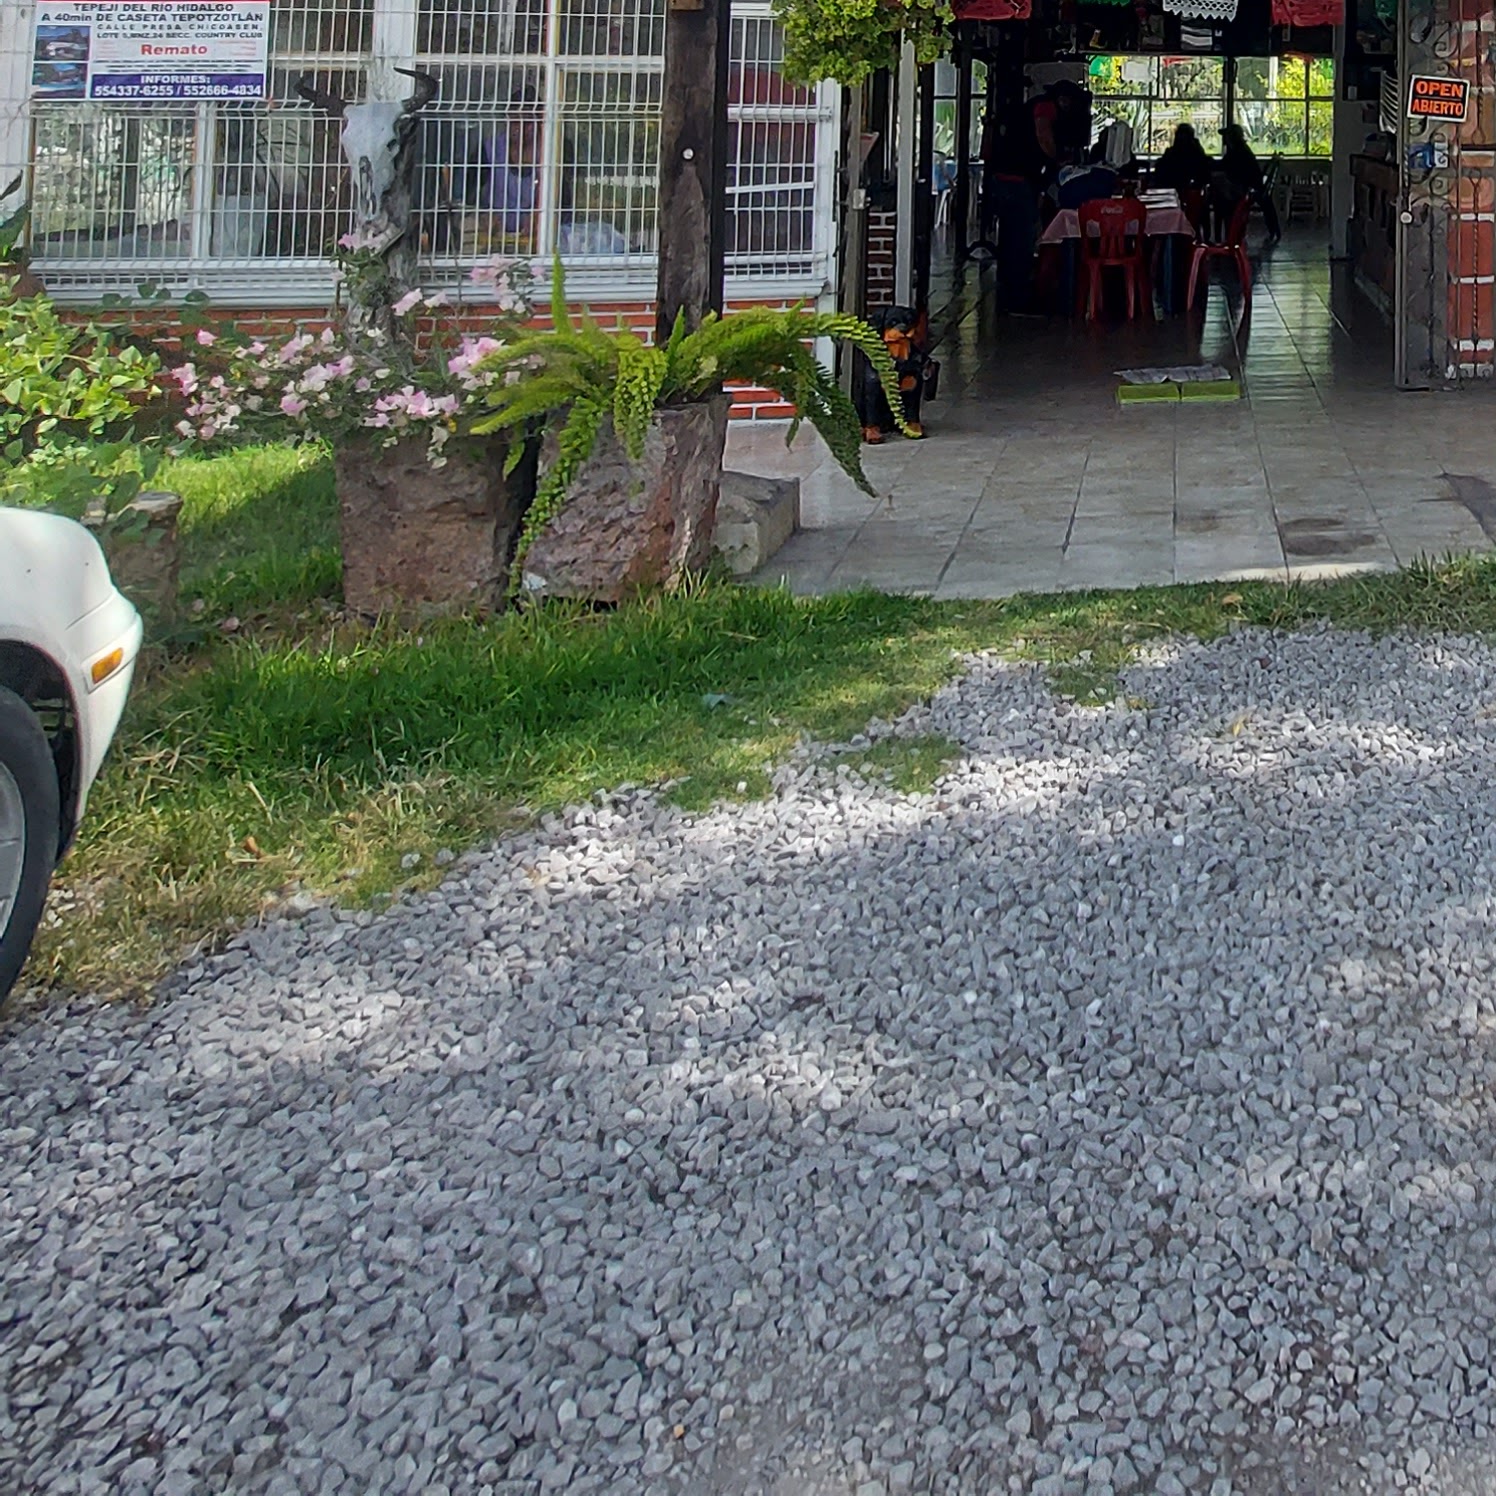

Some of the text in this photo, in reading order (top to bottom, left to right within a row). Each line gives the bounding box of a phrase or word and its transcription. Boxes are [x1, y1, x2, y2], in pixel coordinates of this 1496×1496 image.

[73, 3, 119, 12] TEPEJI
[123, 3, 147, 12] DEL
[176, 3, 234, 12] HIDALGO
[41, 13, 51, 22] A
[54, 13, 93, 22] 40min
[96, 13, 113, 22] DE
[117, 13, 168, 22] CASETA
[141, 44, 208, 55] Remato
[141, 75, 211, 84] INFORMES:
[1415, 80, 1464, 98] OPEN
[1412, 98, 1464, 116] ABIERTO
